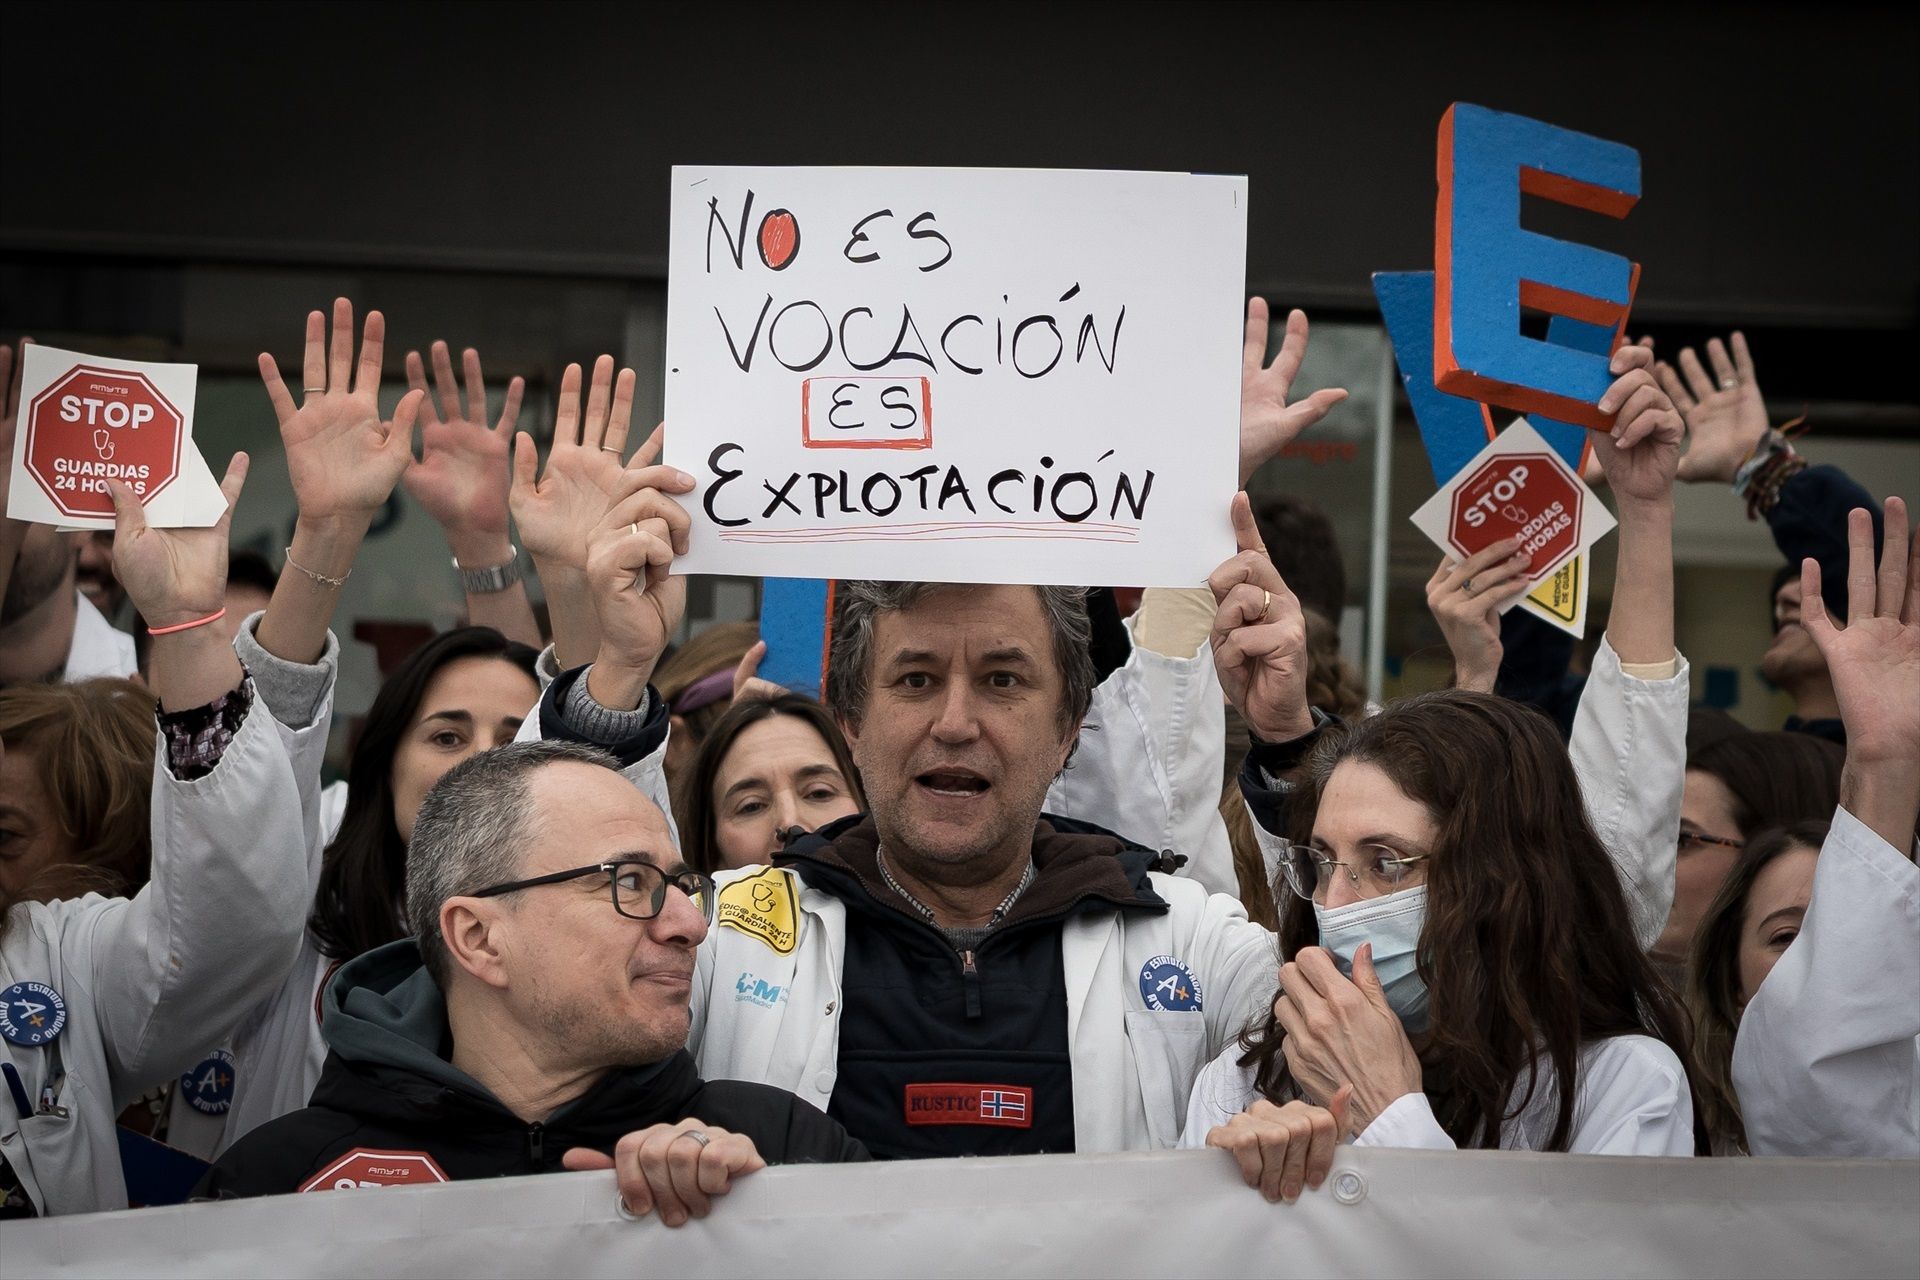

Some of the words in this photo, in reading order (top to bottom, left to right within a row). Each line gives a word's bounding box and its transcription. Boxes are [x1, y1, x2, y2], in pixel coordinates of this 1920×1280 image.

[706, 189, 801, 273] NO
[843, 207, 953, 273] ES
[1434, 101, 1642, 433] E
[713, 282, 1127, 379] VOCACIÓN
[60, 394, 155, 430] STOP
[828, 382, 918, 430] ES
[54, 457, 150, 479] GUARDIAS
[54, 475, 77, 491] 24
[702, 442, 1156, 528] EXPLOTACIÓN
[1463, 464, 1530, 528] STOP
[1514, 500, 1565, 544] ARDIAS
[1523, 512, 1573, 556] HORAS
[724, 910, 768, 932] GUARDIA
[778, 938, 788, 946] H
[750, 912, 793, 940] SALIENTE
[28, 983, 65, 1009] ESTATUTO
[1149, 955, 1186, 970] ESTATUTO
[1184, 964, 1203, 1004] PROPIO
[44, 1010, 66, 1039] PROPIO
[911, 1096, 977, 1112] RUSTIC
